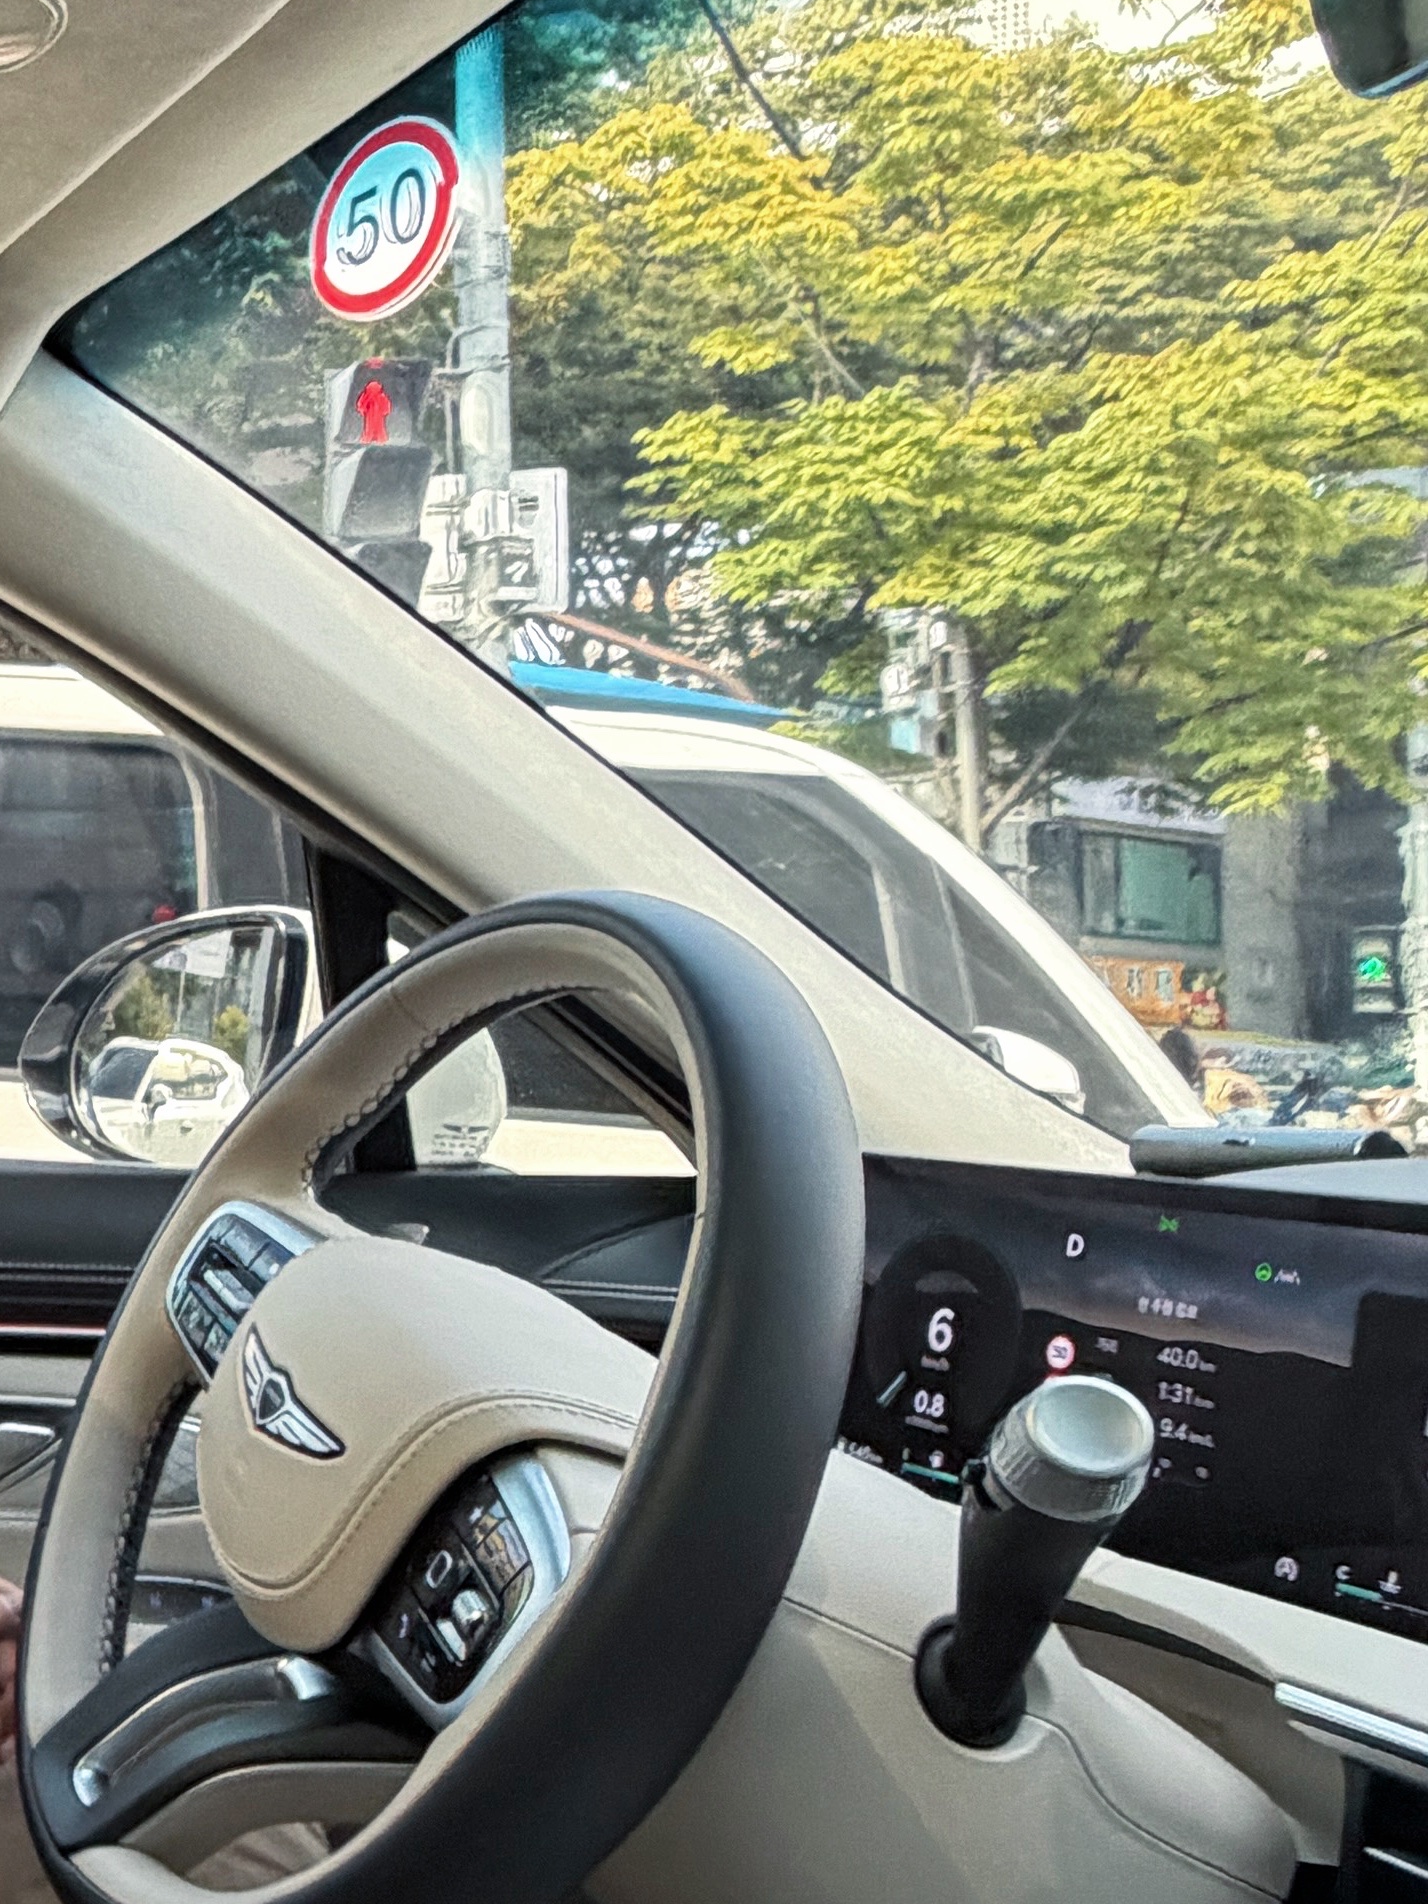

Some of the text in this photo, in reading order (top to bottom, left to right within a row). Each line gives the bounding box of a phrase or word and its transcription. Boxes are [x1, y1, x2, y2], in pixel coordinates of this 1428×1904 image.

[336, 167, 426, 267] 50
[1066, 1233, 1085, 1257] D
[928, 1307, 955, 1353] 6
[913, 1389, 945, 1418] 0.8
